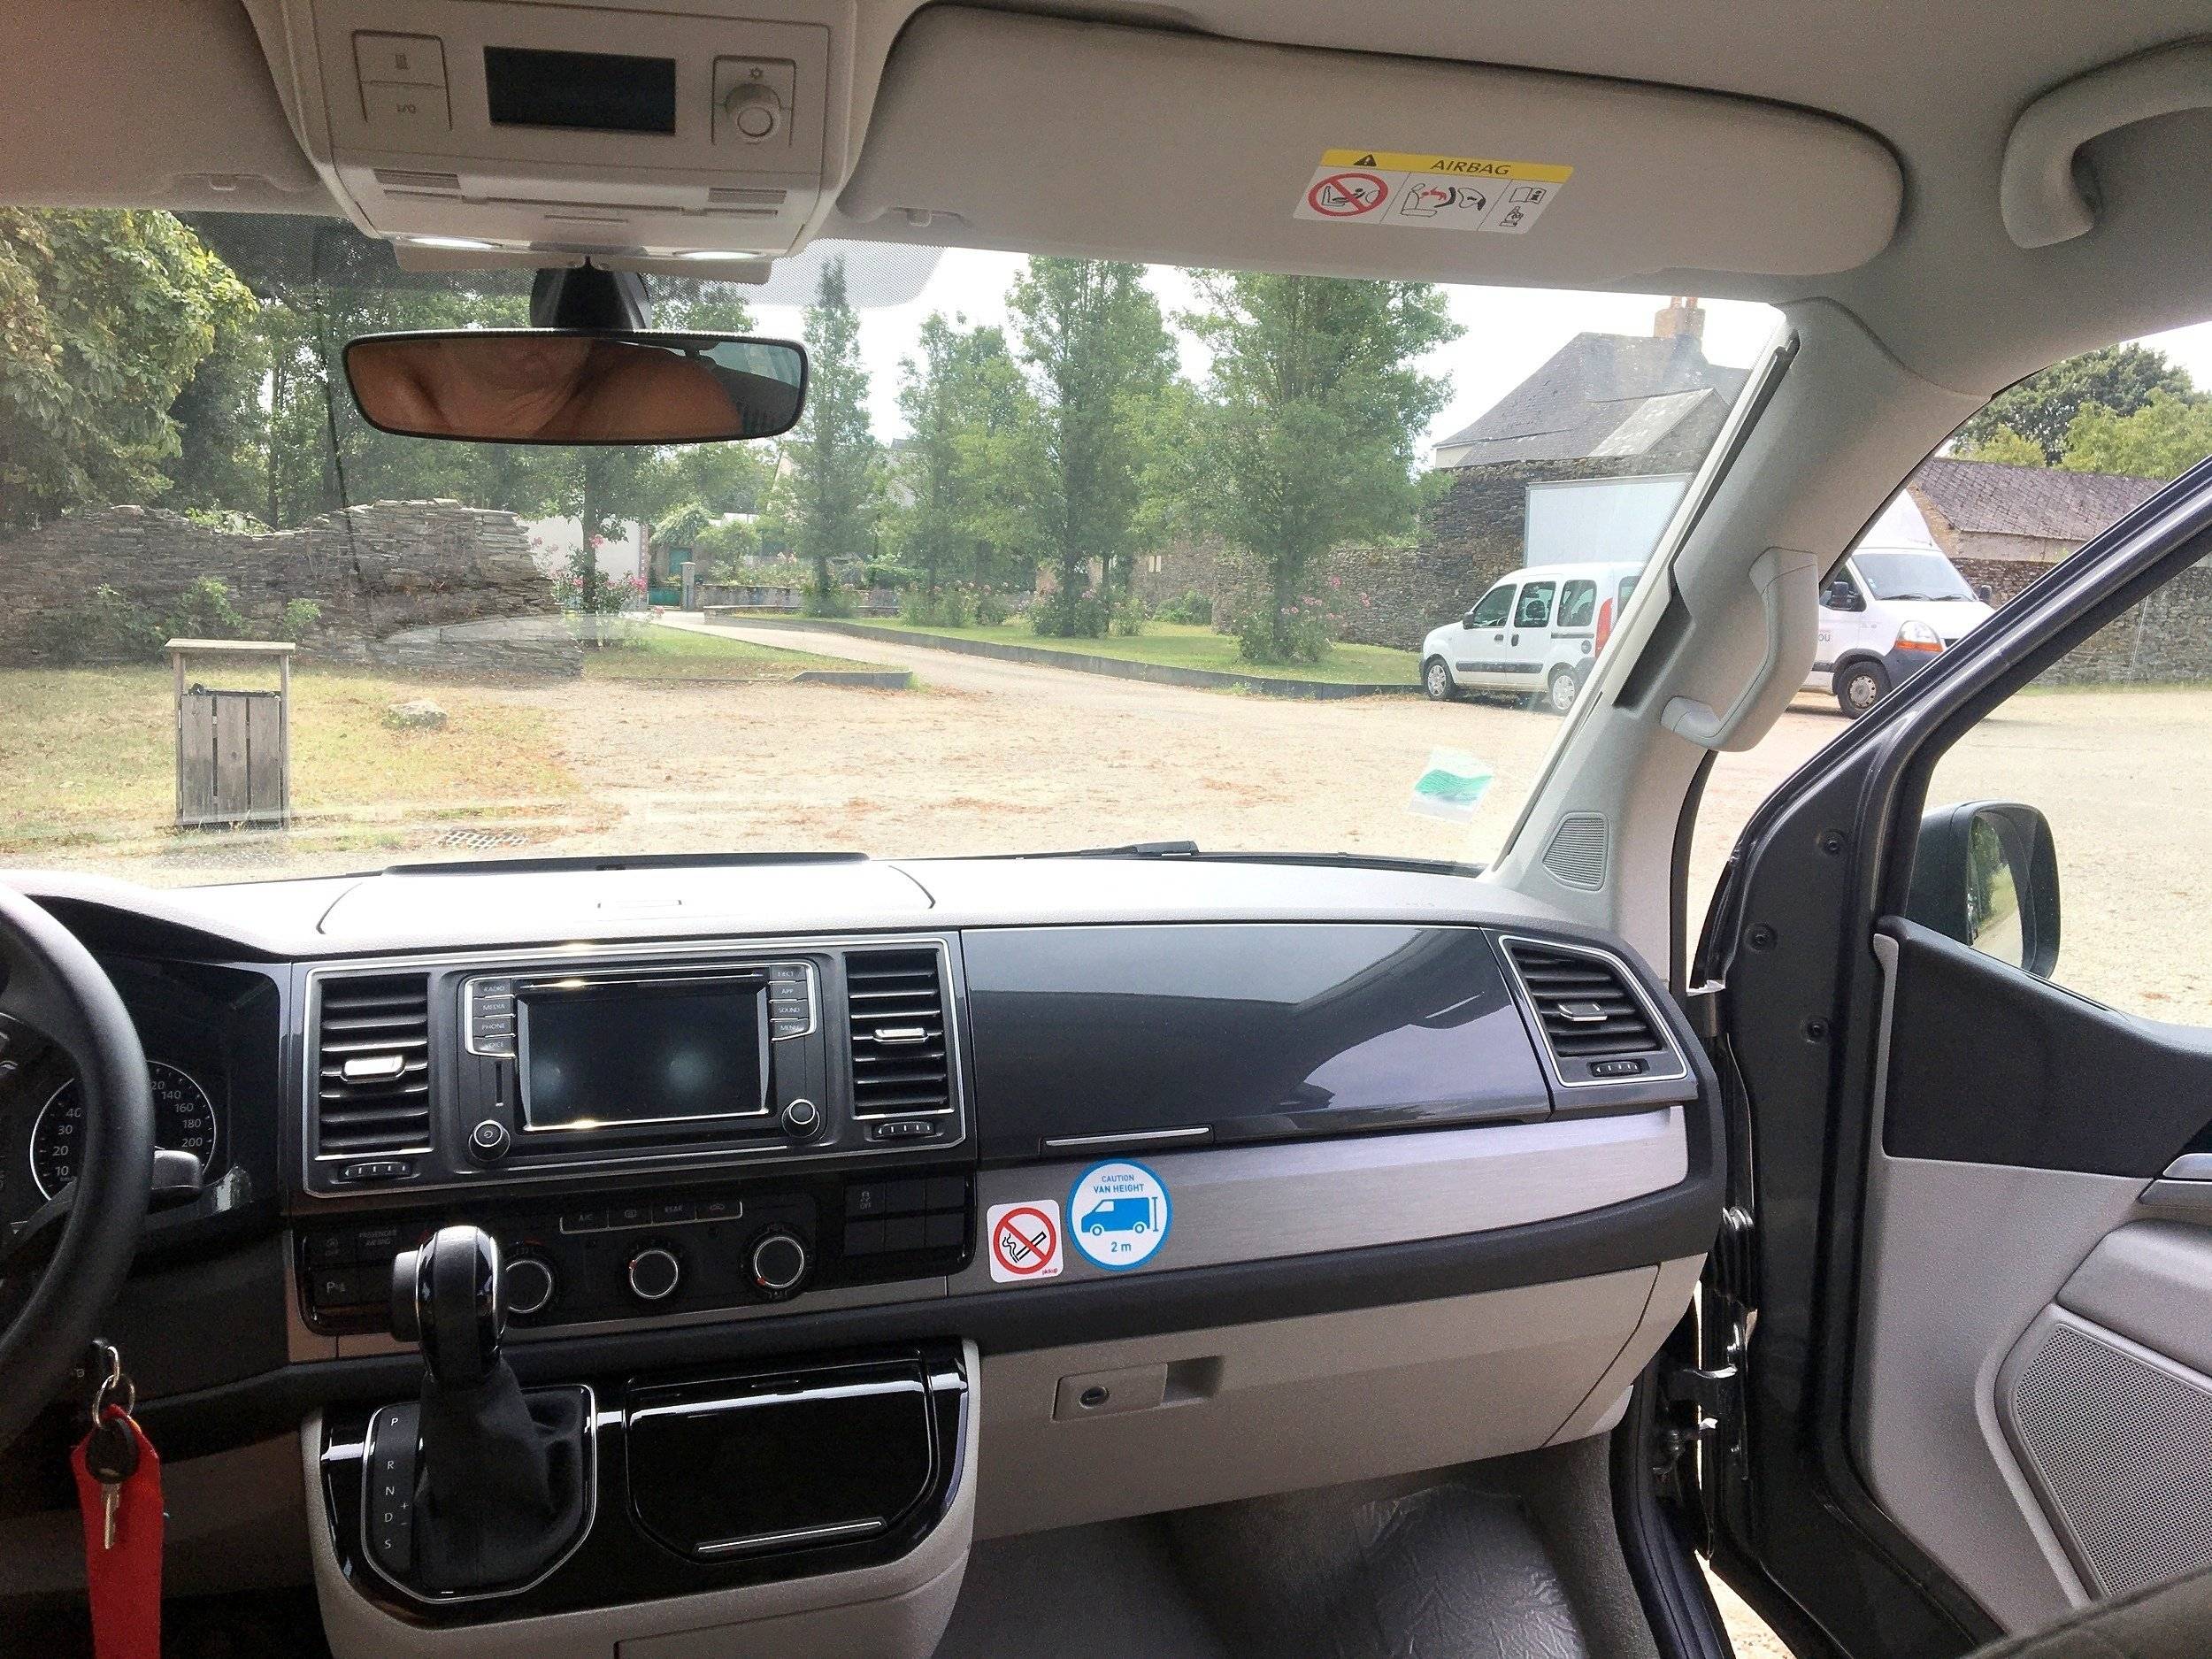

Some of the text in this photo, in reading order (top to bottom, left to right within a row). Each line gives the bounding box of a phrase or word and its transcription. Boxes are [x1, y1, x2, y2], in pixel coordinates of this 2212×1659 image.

[1430, 159, 1511, 175] AIRBAG
[150, 1080, 165, 1090] 20
[162, 1090, 182, 1100] 140
[175, 1102, 194, 1112] 160
[182, 1118, 202, 1128] 180
[58, 1125, 73, 1135] 30
[181, 1137, 203, 1148] 200
[52, 1145, 69, 1156] 20
[55, 1165, 69, 1176] 10
[1094, 1183, 1145, 1194] VAN HEIGHT
[578, 1213, 595, 1223] A/C
[1110, 1241, 1118, 1252] 2
[390, 1417, 399, 1426] P
[387, 1461, 395, 1470] R
[385, 1486, 395, 1495] N
[384, 1513, 393, 1522] D
[384, 1540, 392, 1548] S
